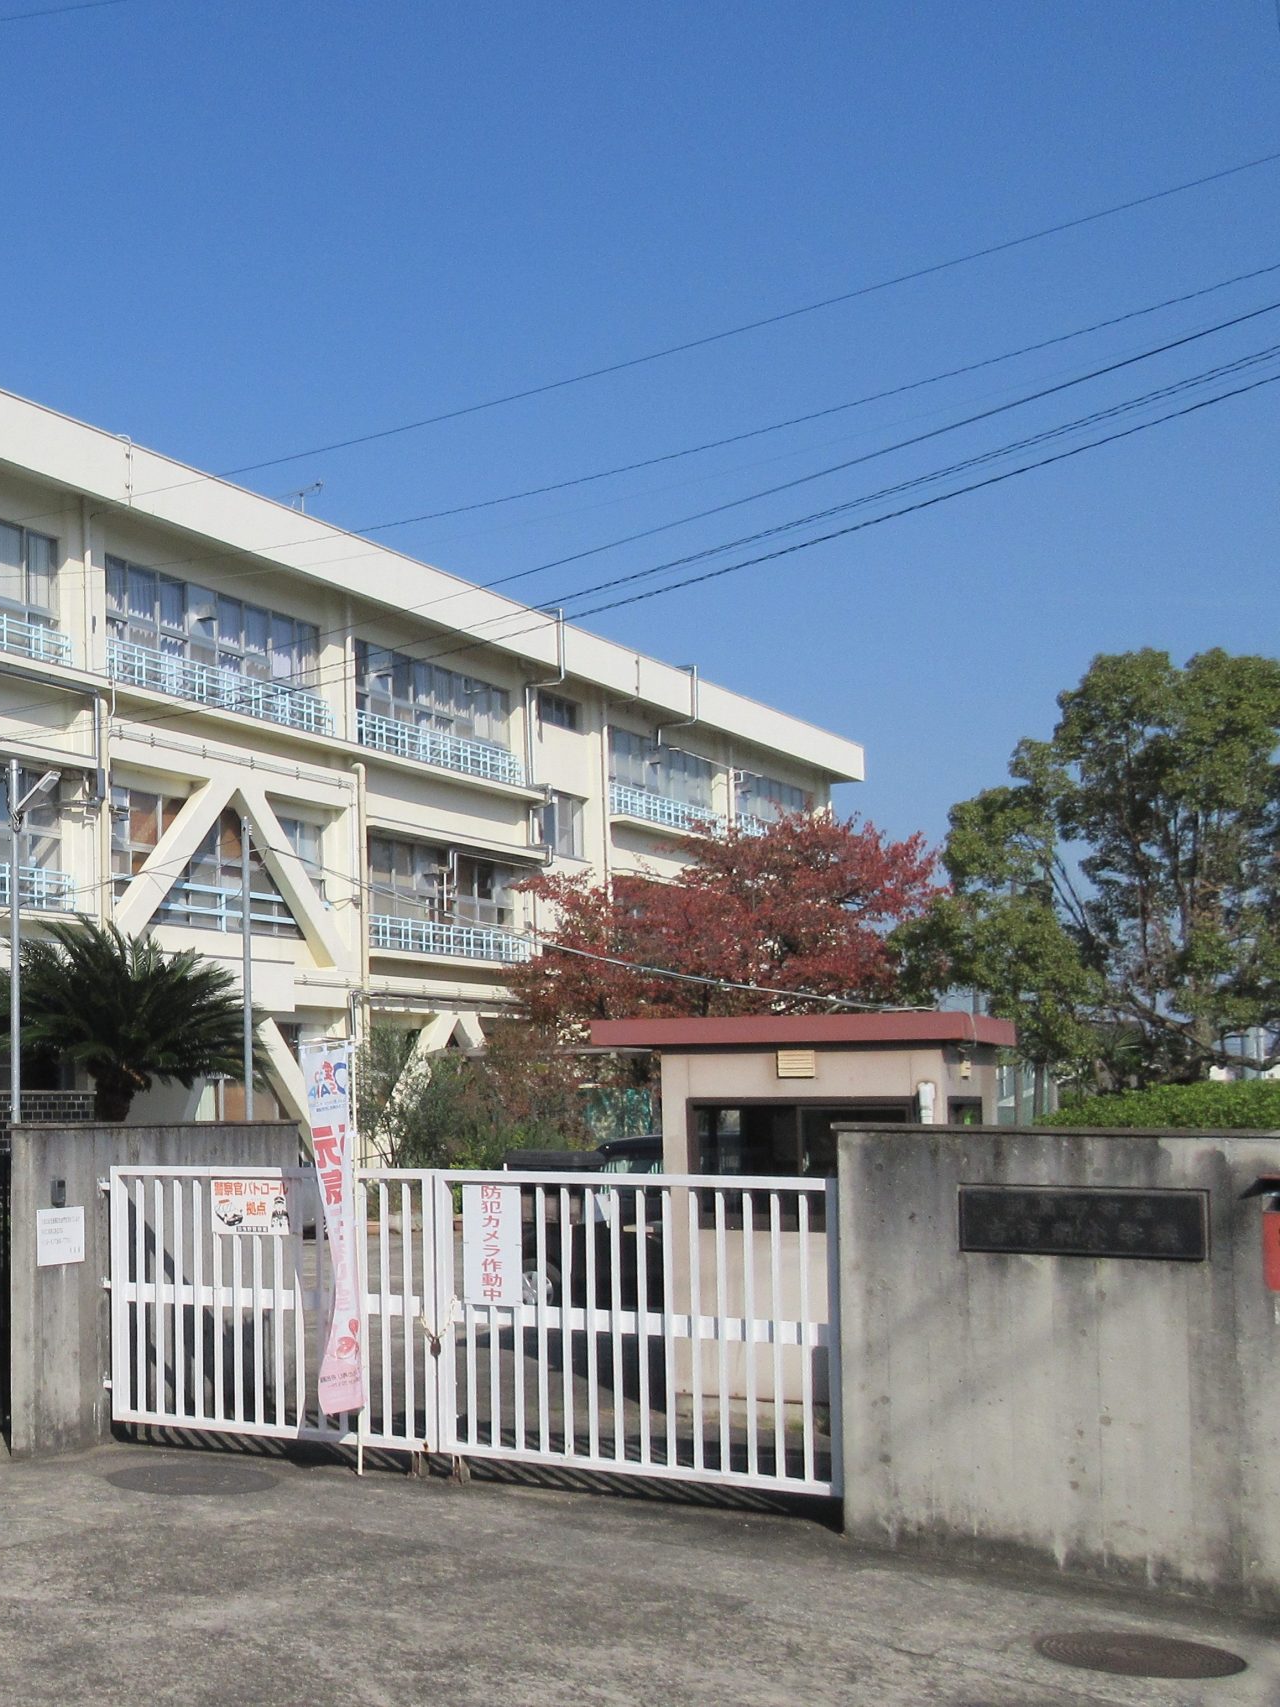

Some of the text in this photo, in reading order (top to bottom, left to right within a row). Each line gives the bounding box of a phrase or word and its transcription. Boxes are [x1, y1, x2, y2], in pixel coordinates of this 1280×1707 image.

[214, 1181, 289, 1196] 警察官パトロール
[246, 1200, 267, 1216] 拠点
[481, 1185, 503, 1301] 防犯カメラ作動中
